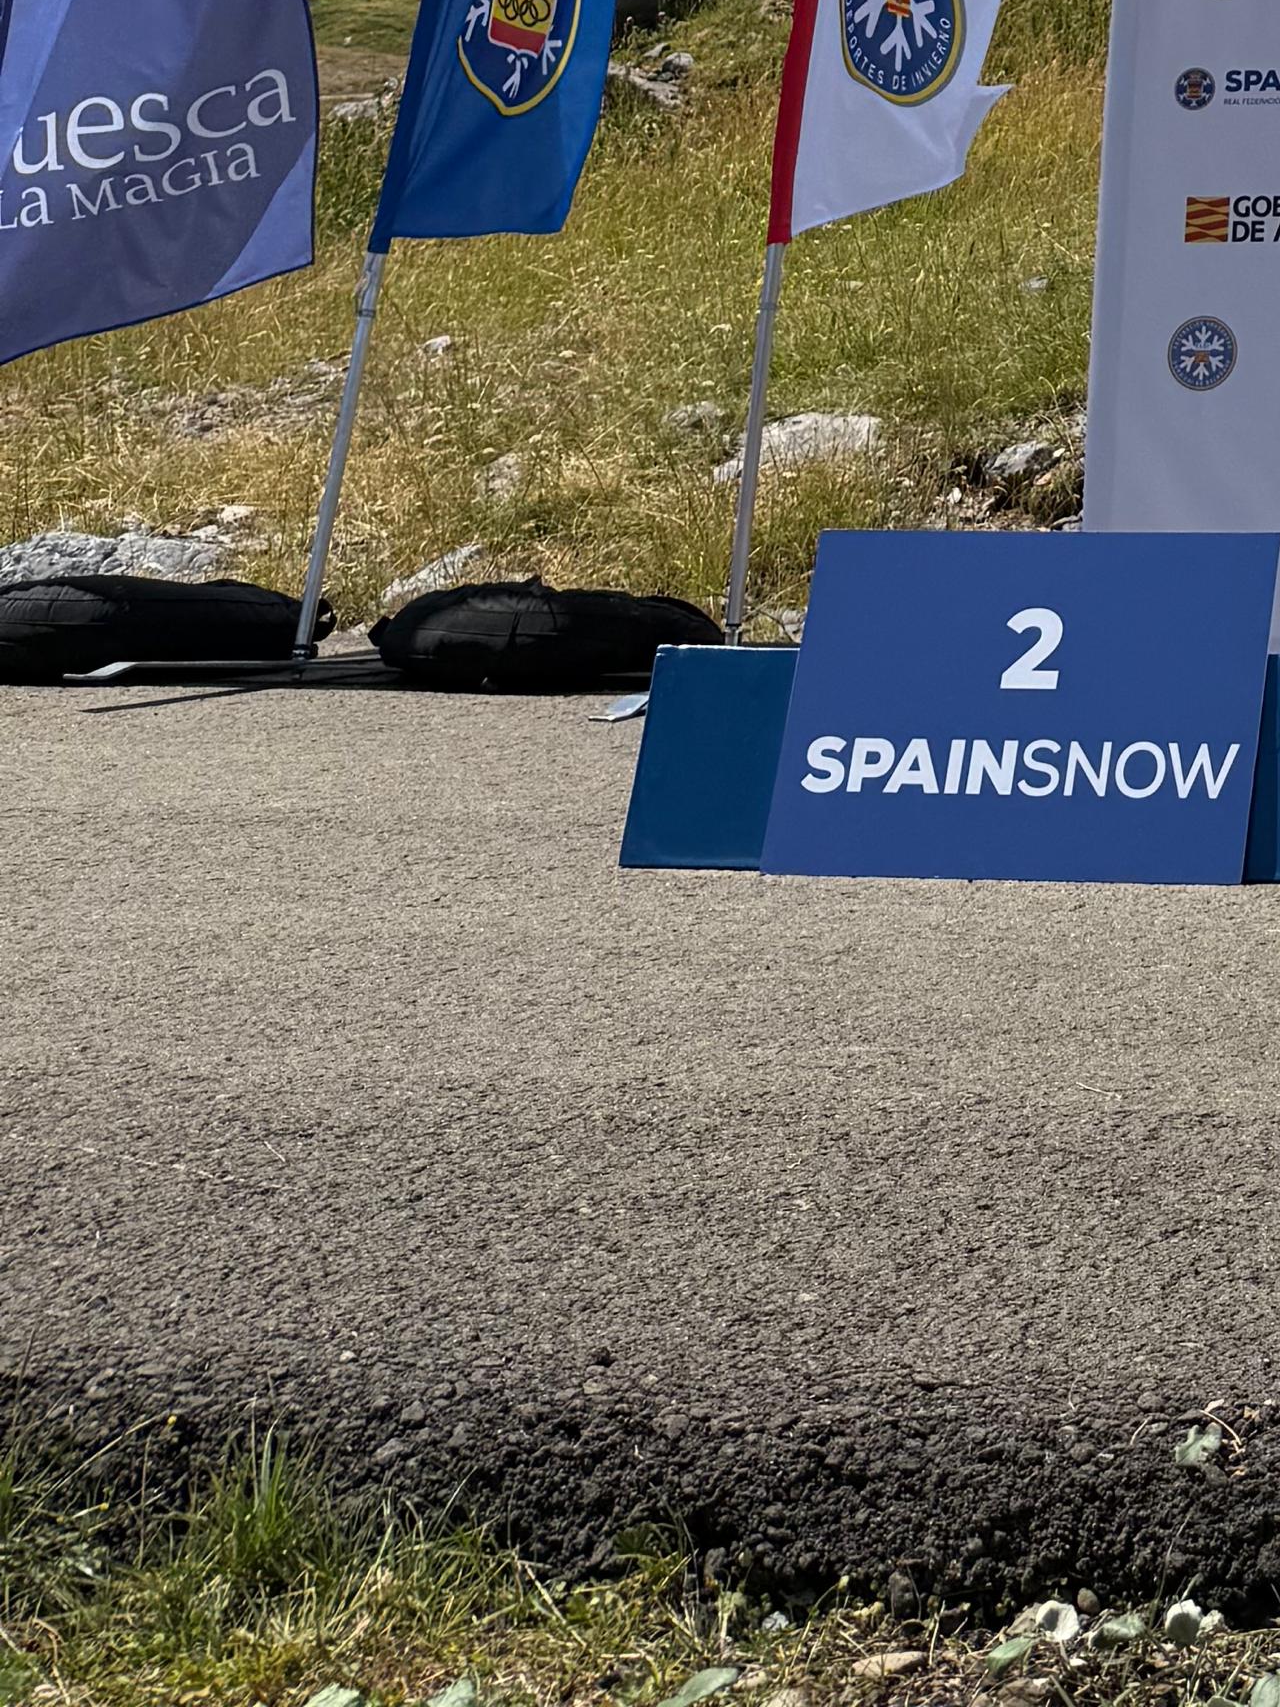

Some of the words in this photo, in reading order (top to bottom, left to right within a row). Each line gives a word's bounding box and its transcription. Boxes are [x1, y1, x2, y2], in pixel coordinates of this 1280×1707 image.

[892, 71, 907, 91] DE
[911, 16, 951, 88] INVIERNO
[12, 68, 297, 175] uesca
[1231, 220, 1264, 243] DE
[1000, 607, 1064, 690] 2
[800, 735, 1240, 800] SPAINSNOW
